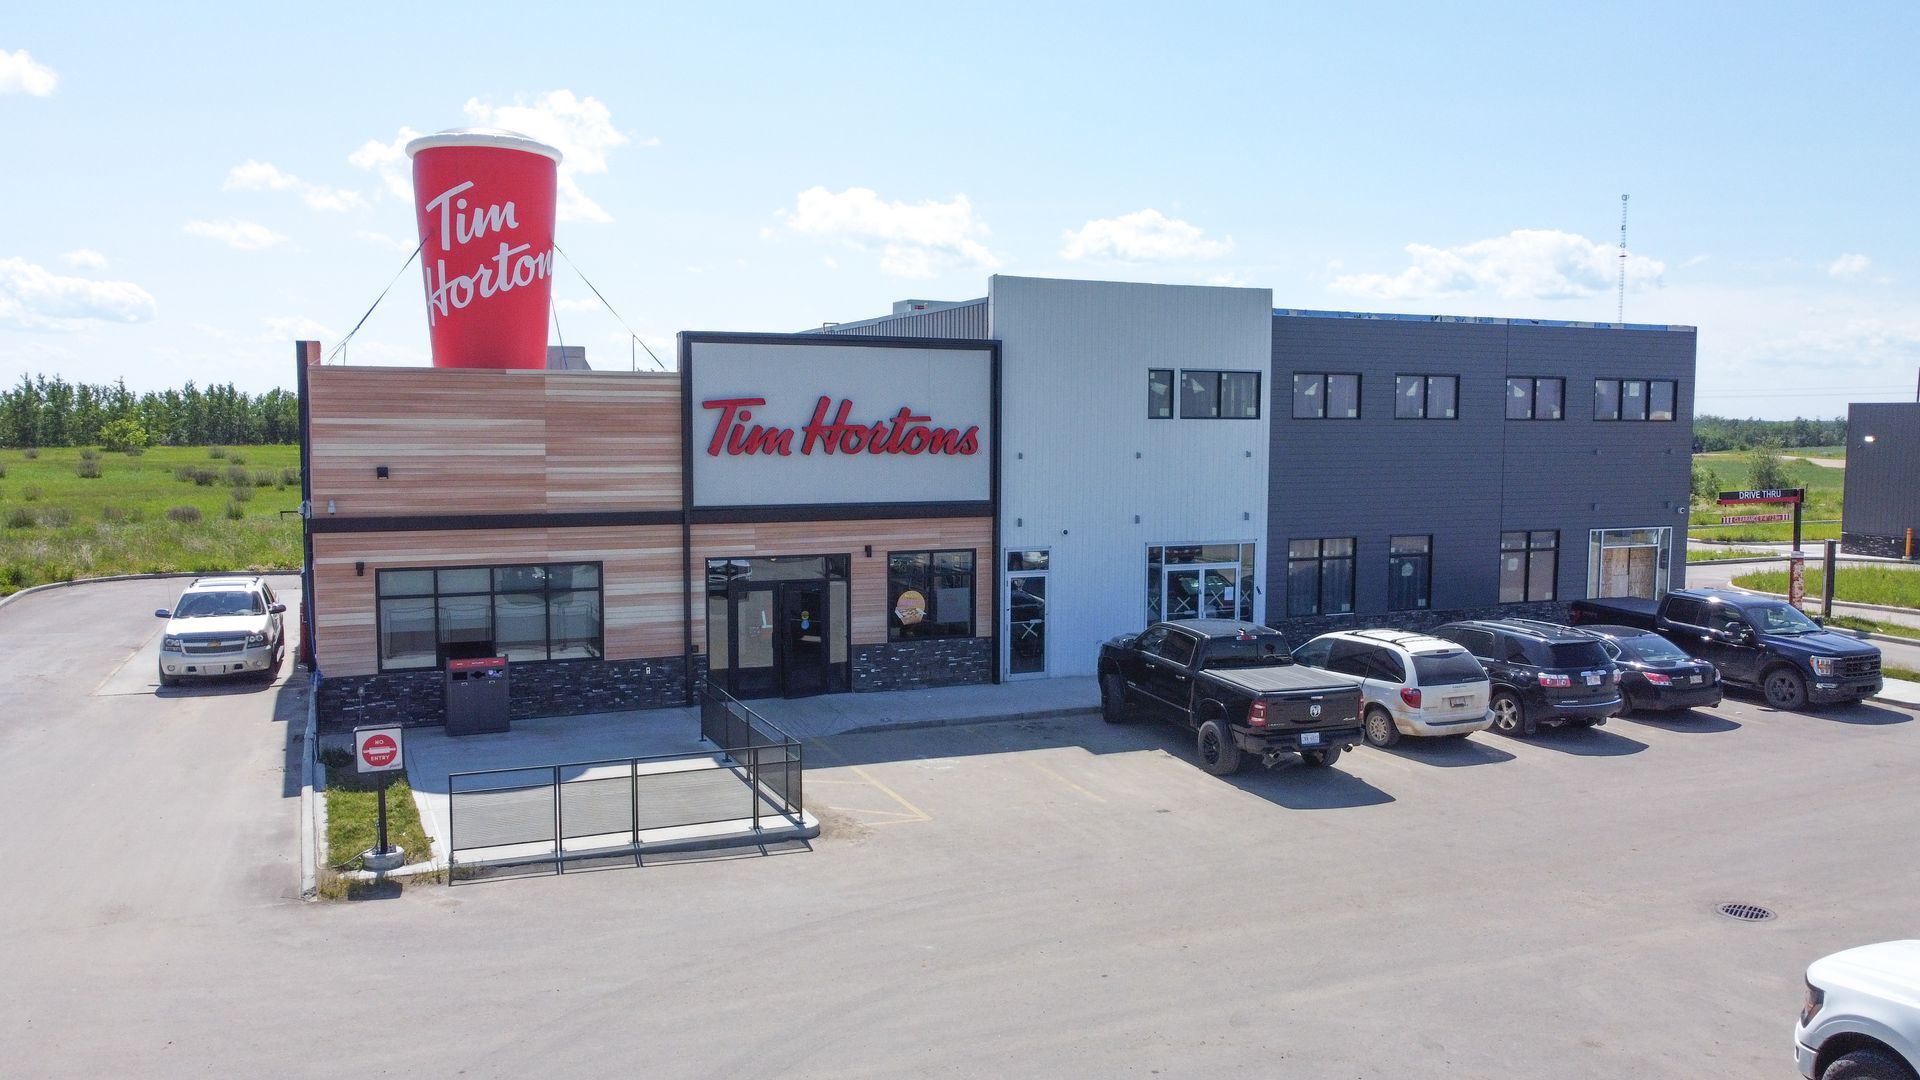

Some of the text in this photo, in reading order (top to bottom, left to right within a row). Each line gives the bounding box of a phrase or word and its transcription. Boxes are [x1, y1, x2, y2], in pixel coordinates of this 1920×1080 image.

[425, 180, 519, 251] Tim
[702, 395, 980, 457] Tim Hortons
[1739, 490, 1781, 499] DRIVE THRU
